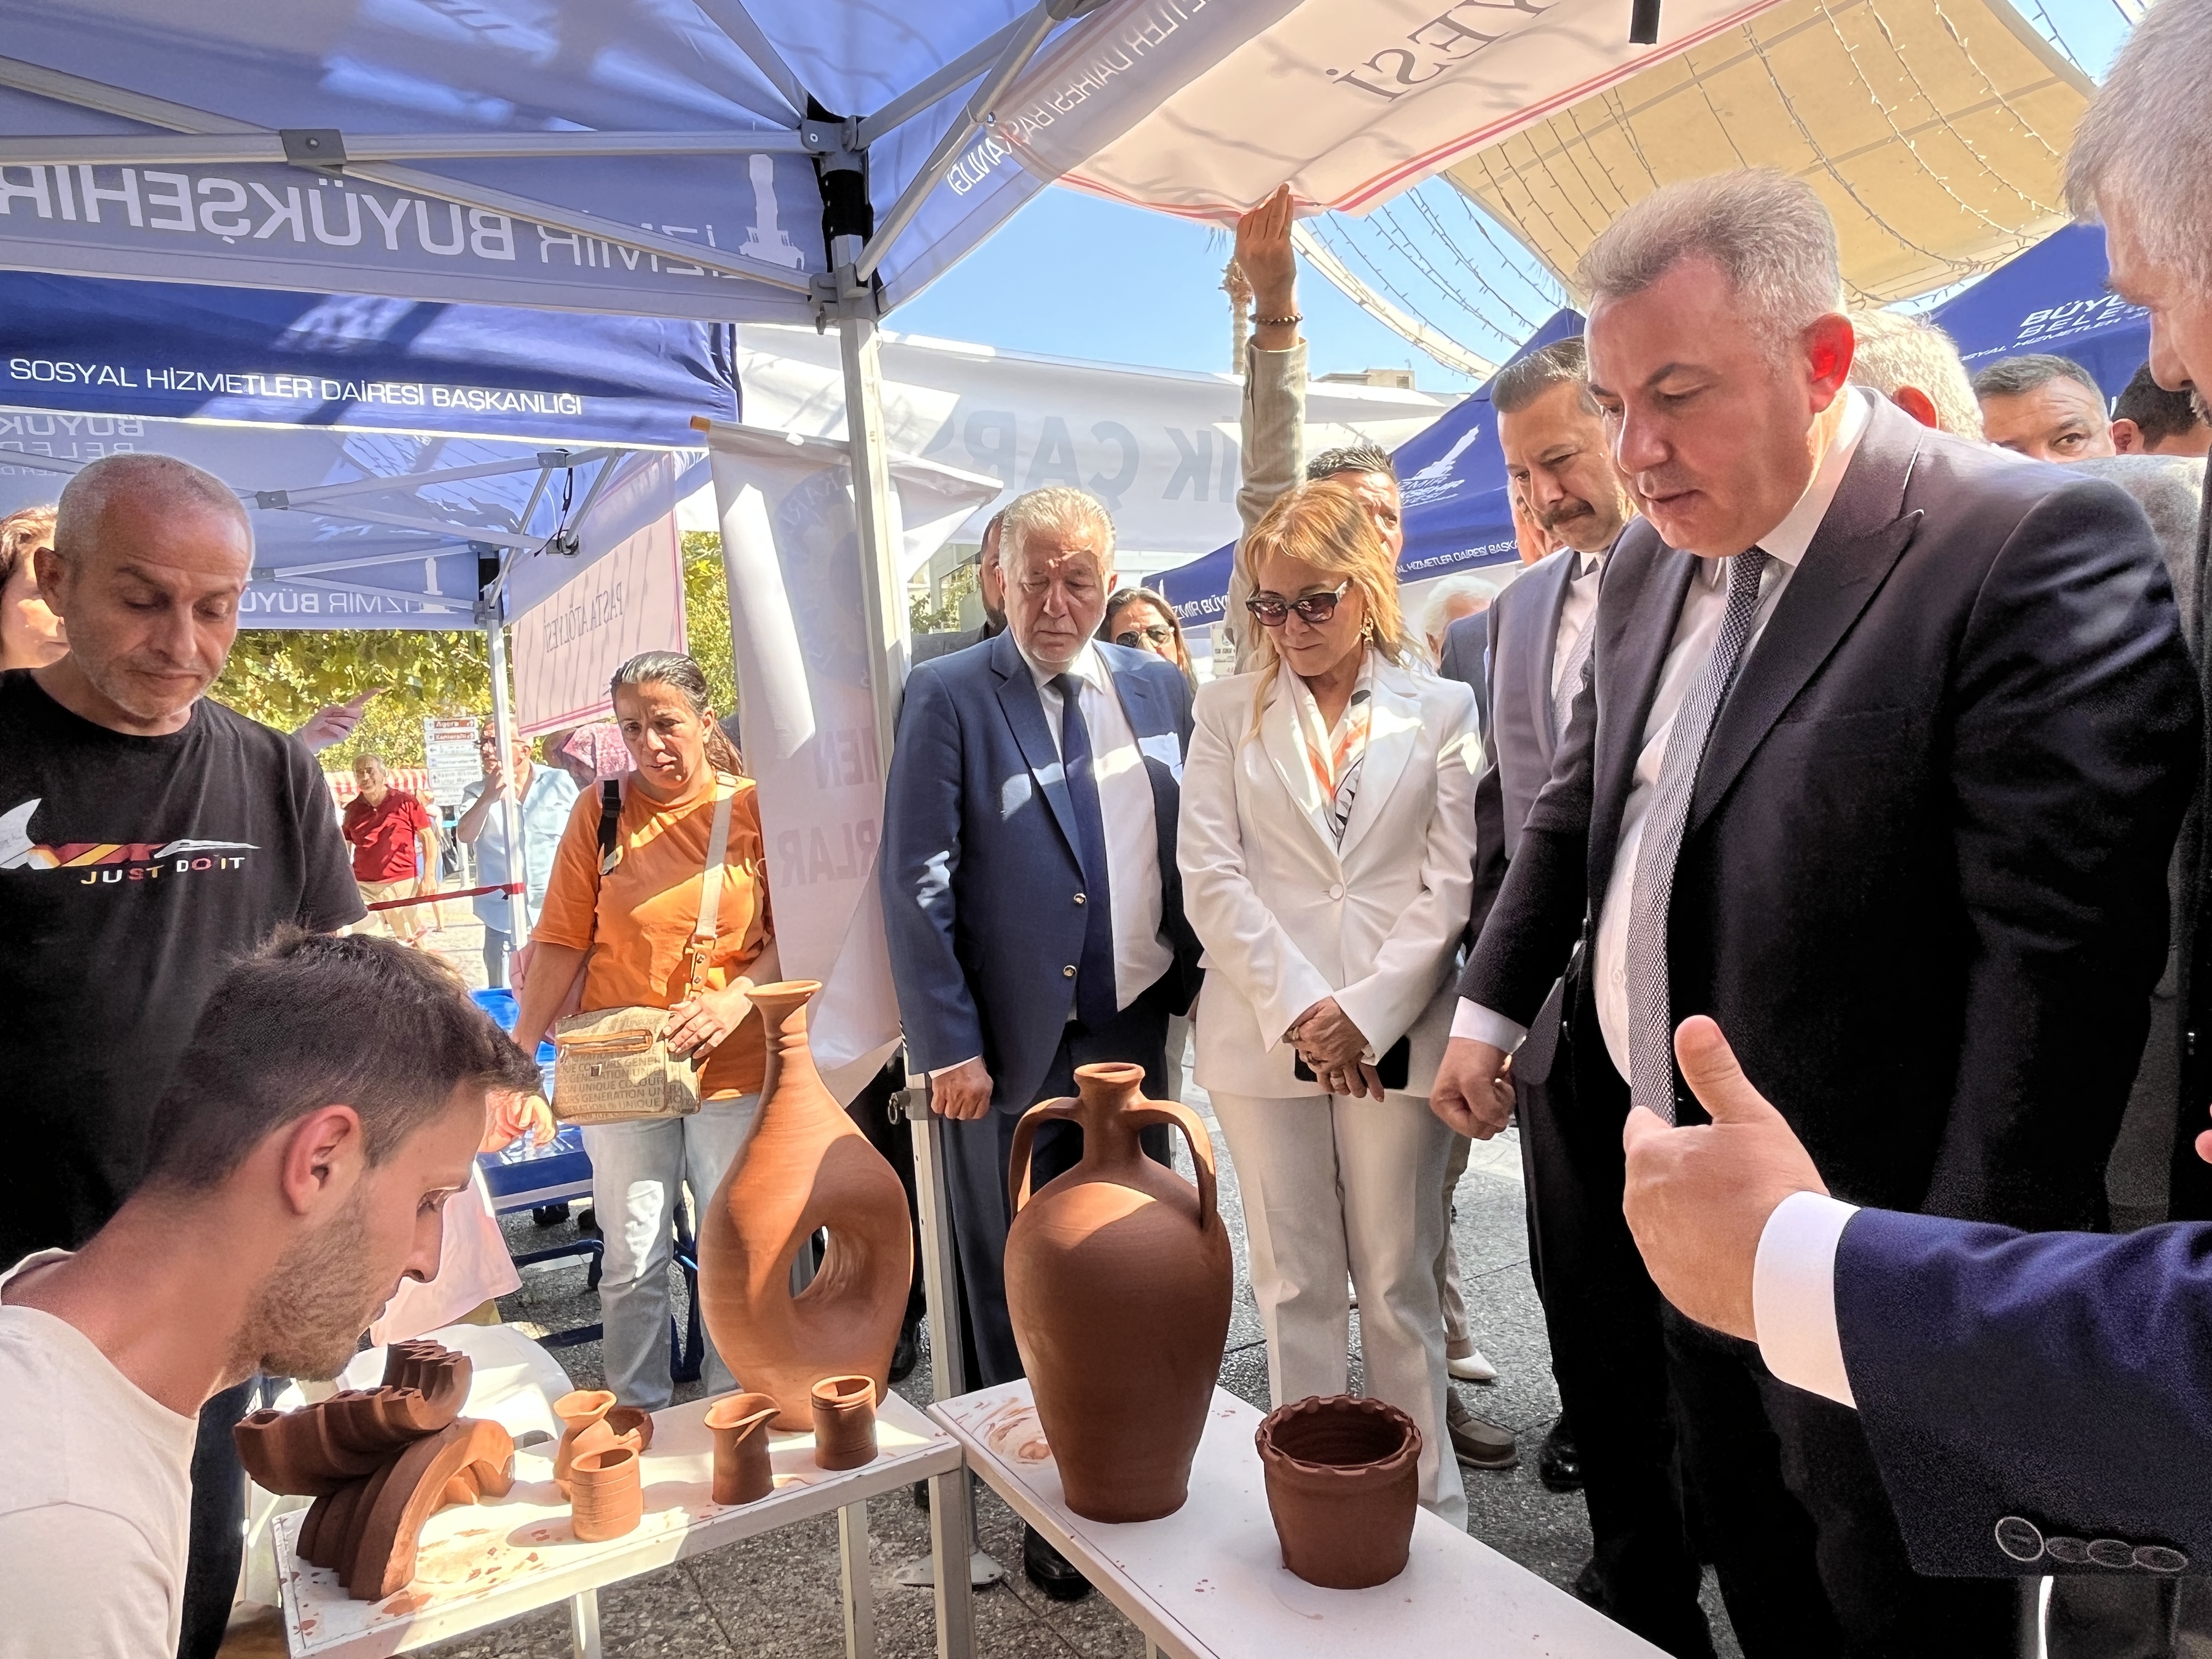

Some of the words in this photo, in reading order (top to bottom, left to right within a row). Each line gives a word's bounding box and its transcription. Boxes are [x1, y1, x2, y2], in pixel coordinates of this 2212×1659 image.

[10, 358, 138, 387] SOSYAL
[146, 366, 312, 399] HİZMETLER
[321, 379, 424, 405] DAİRESİ
[432, 387, 582, 415] BAŞKANLIĞI
[81, 865, 164, 884] JUST
[176, 857, 212, 873] DO
[221, 857, 245, 870] IT
